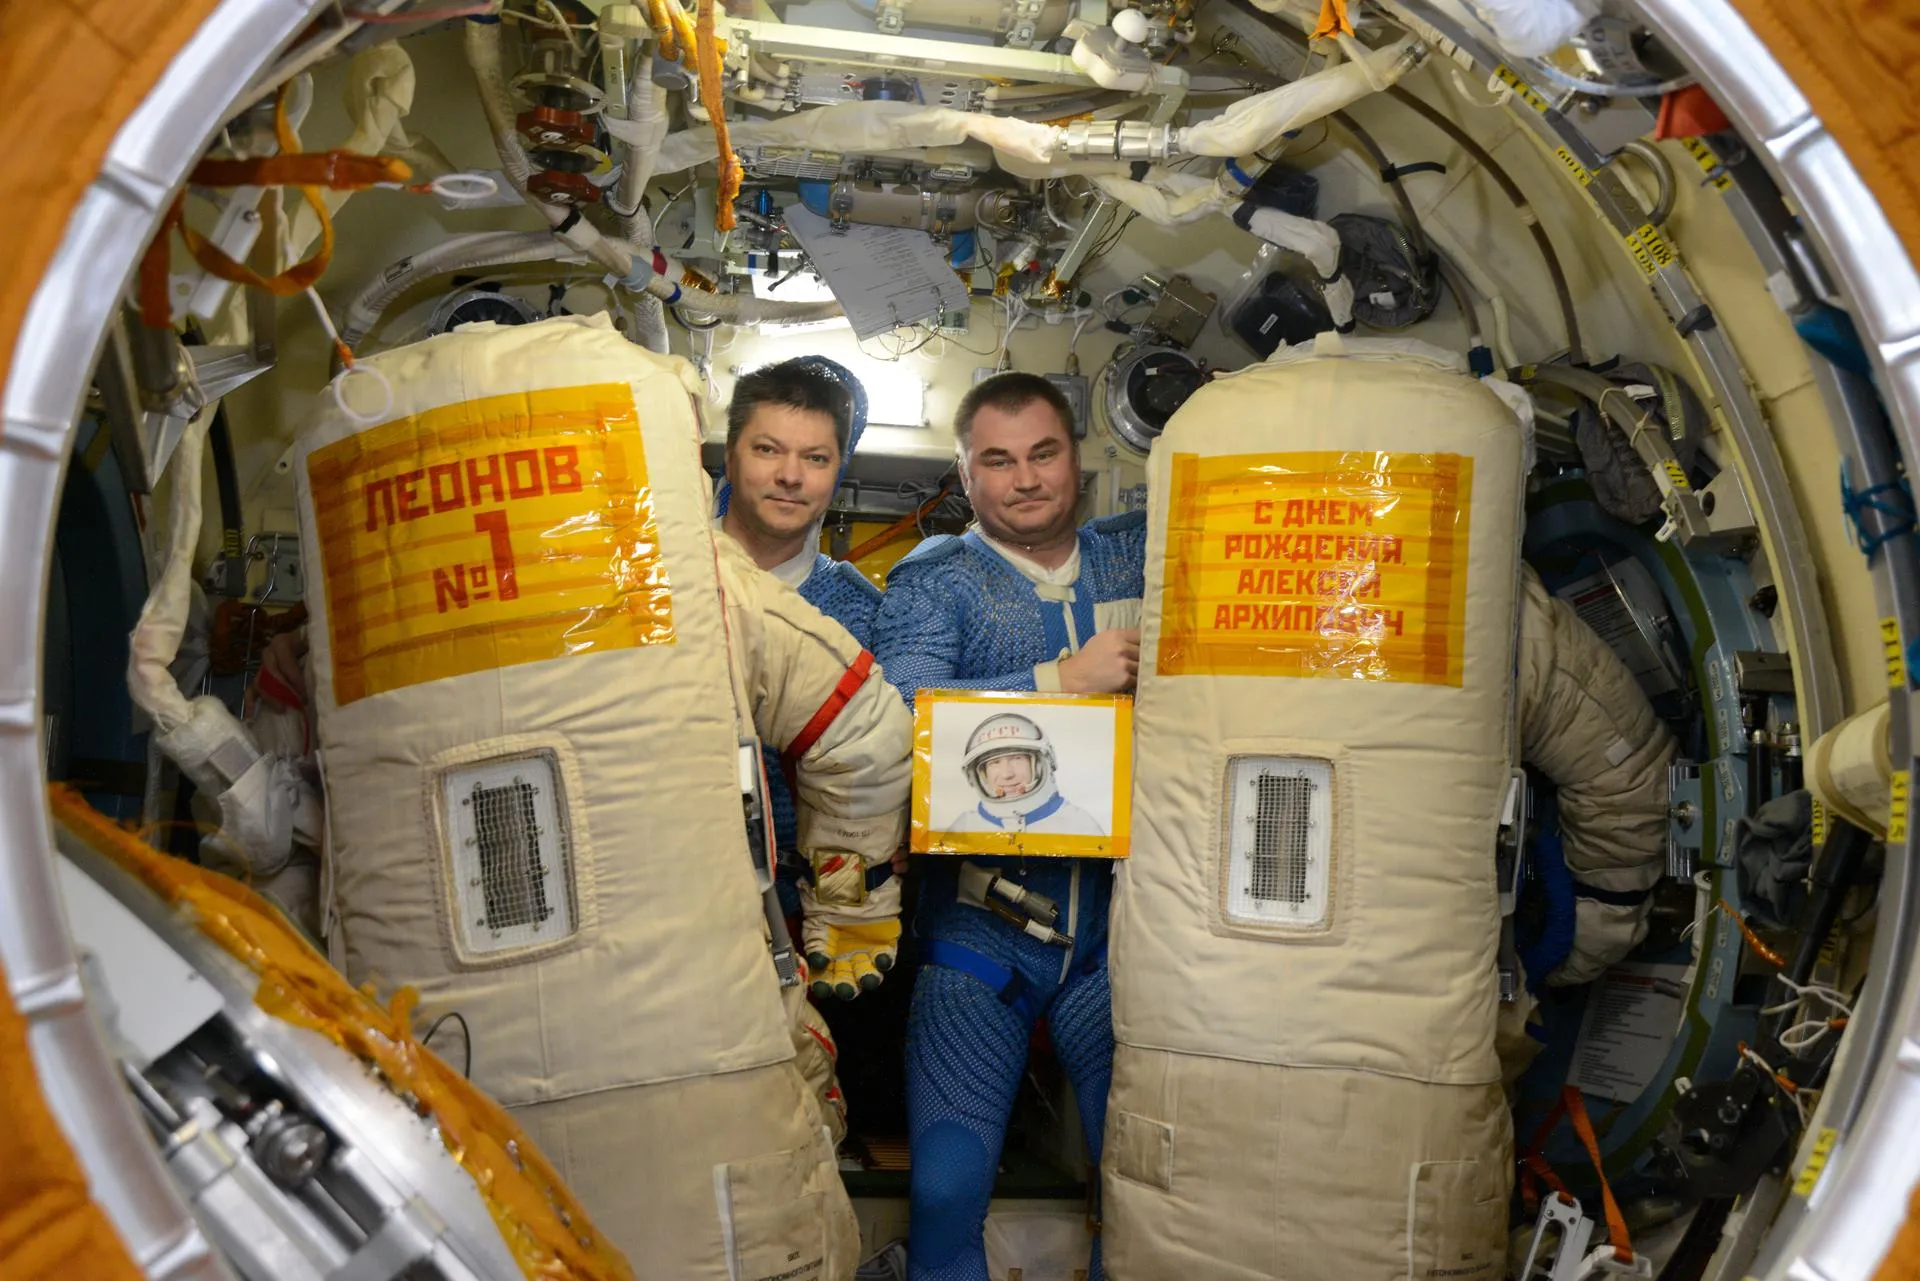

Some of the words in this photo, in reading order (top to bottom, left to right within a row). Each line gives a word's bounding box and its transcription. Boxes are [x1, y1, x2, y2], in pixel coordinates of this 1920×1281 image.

[1642, 226, 1672, 266] 3108
[364, 445, 582, 532] ЛЕОНОВ
[1254, 500, 1272, 524] С
[1282, 500, 1373, 528] ДНЕМ
[1225, 534, 1403, 564] РОЖДЕНИЯ
